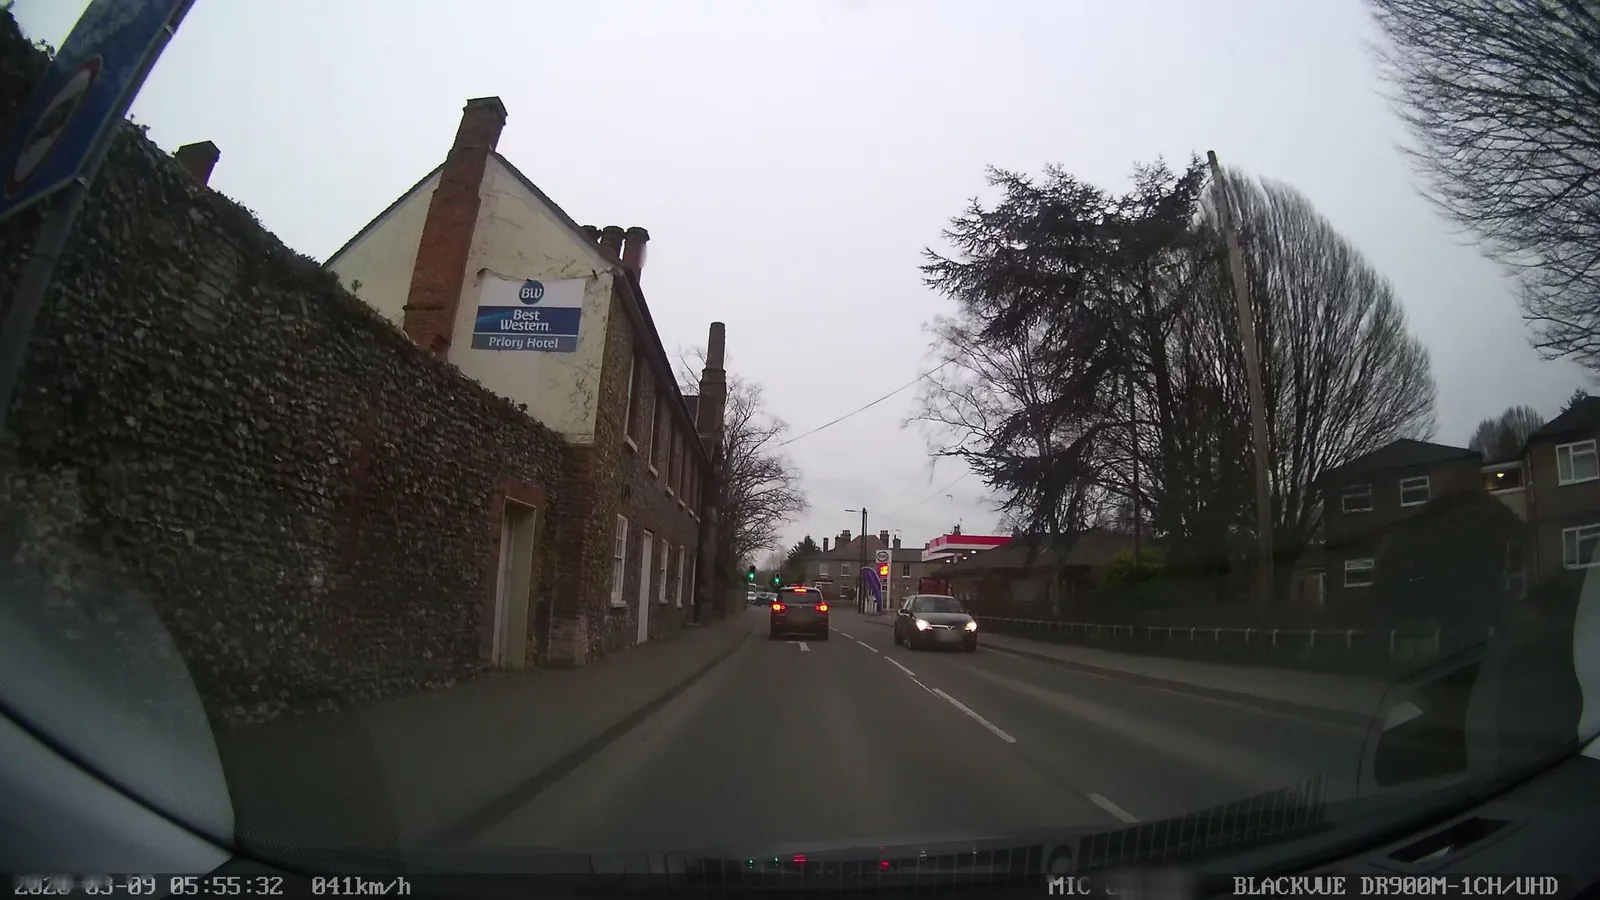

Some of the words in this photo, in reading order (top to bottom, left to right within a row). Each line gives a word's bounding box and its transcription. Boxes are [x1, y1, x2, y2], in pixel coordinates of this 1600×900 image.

[521, 287, 542, 299] BW
[513, 309, 540, 320] Best
[500, 319, 549, 332] Western
[488, 336, 524, 349] Priory
[526, 337, 559, 349] Hotel
